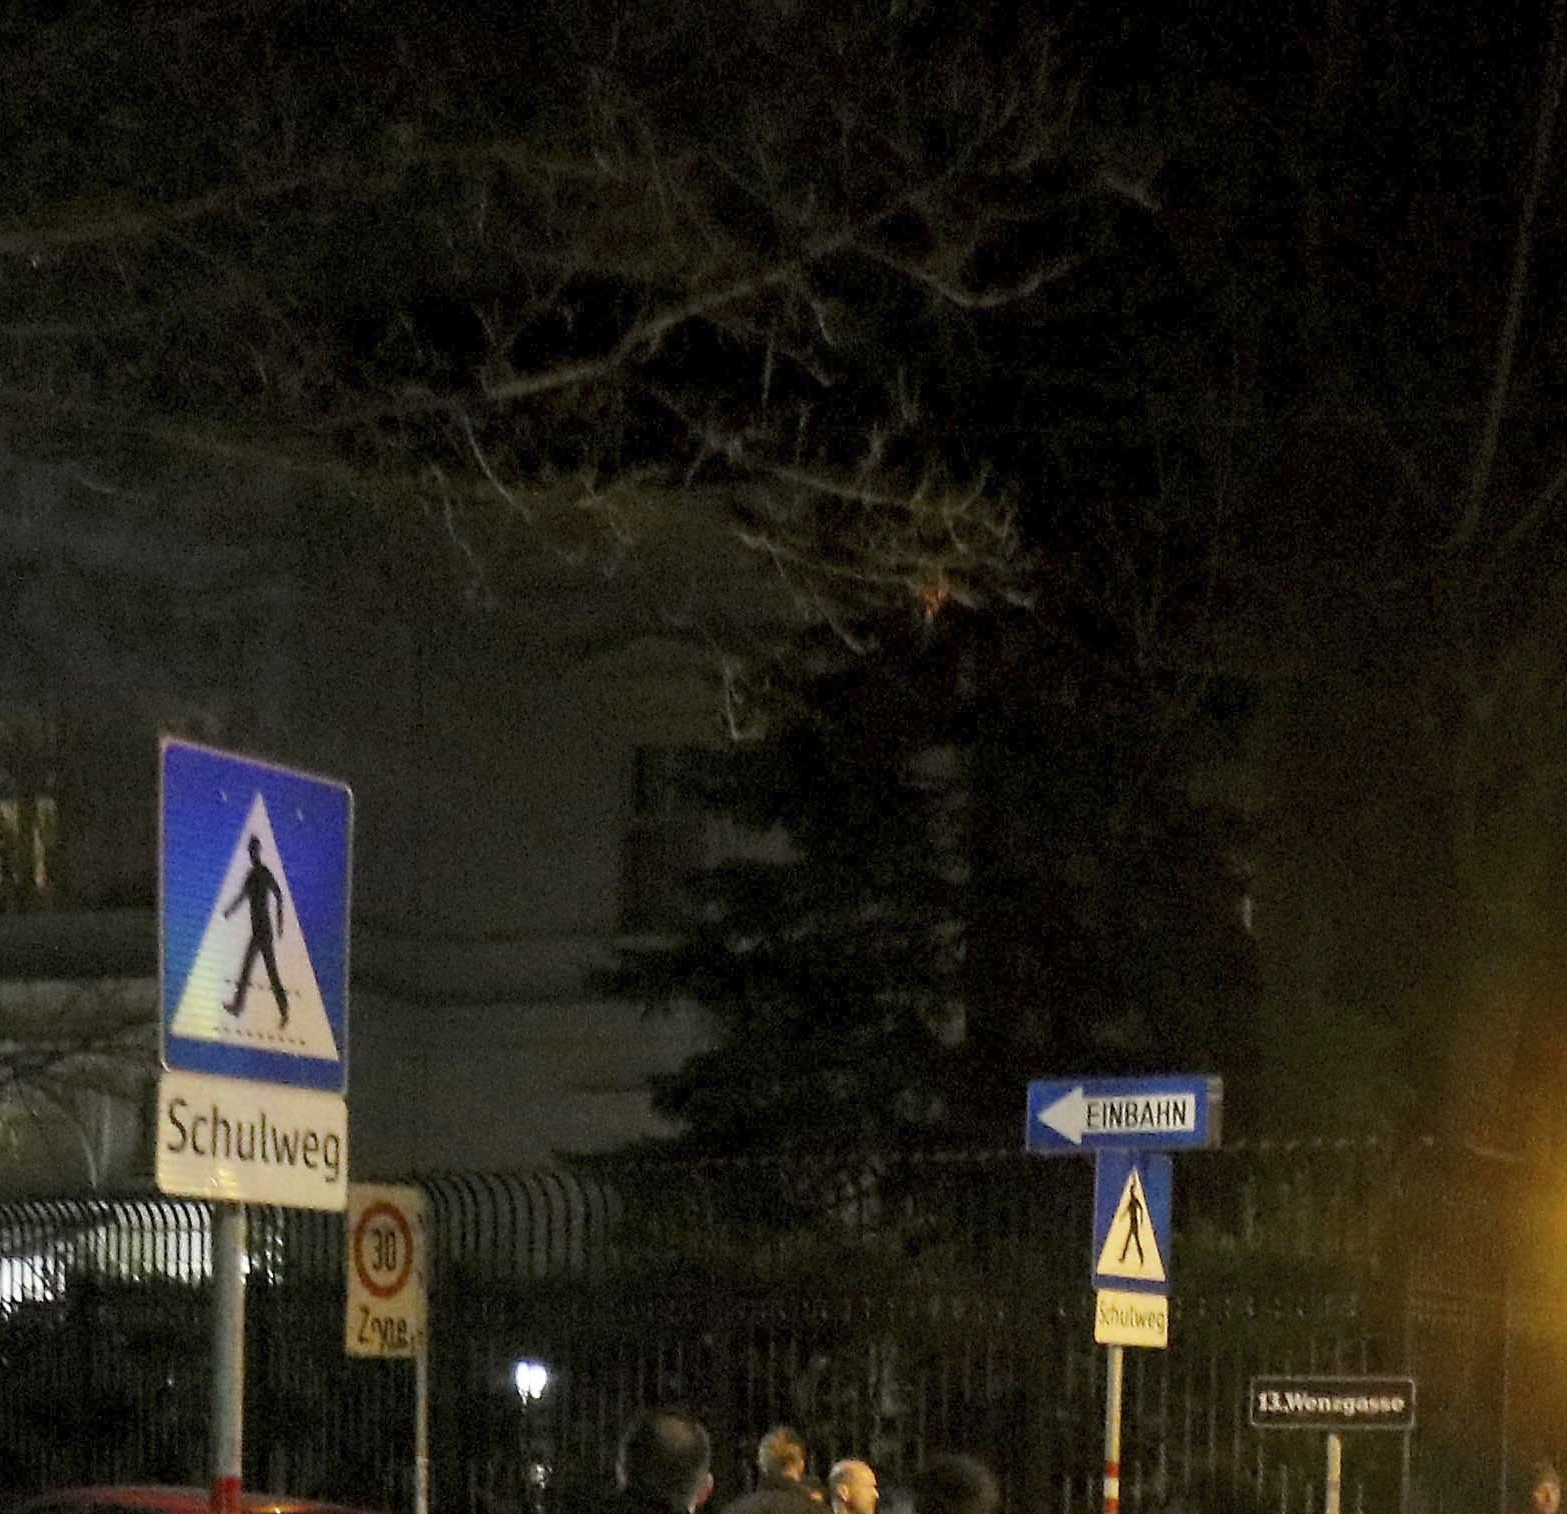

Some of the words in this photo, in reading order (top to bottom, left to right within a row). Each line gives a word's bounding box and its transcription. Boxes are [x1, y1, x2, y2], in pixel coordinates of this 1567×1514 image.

[1087, 1100, 1186, 1128] EINBAHN
[166, 1099, 341, 1181] Schulweg
[371, 1228, 397, 1272] 30
[357, 1304, 409, 1349] Zone
[1099, 1301, 1167, 1334] Schulweg
